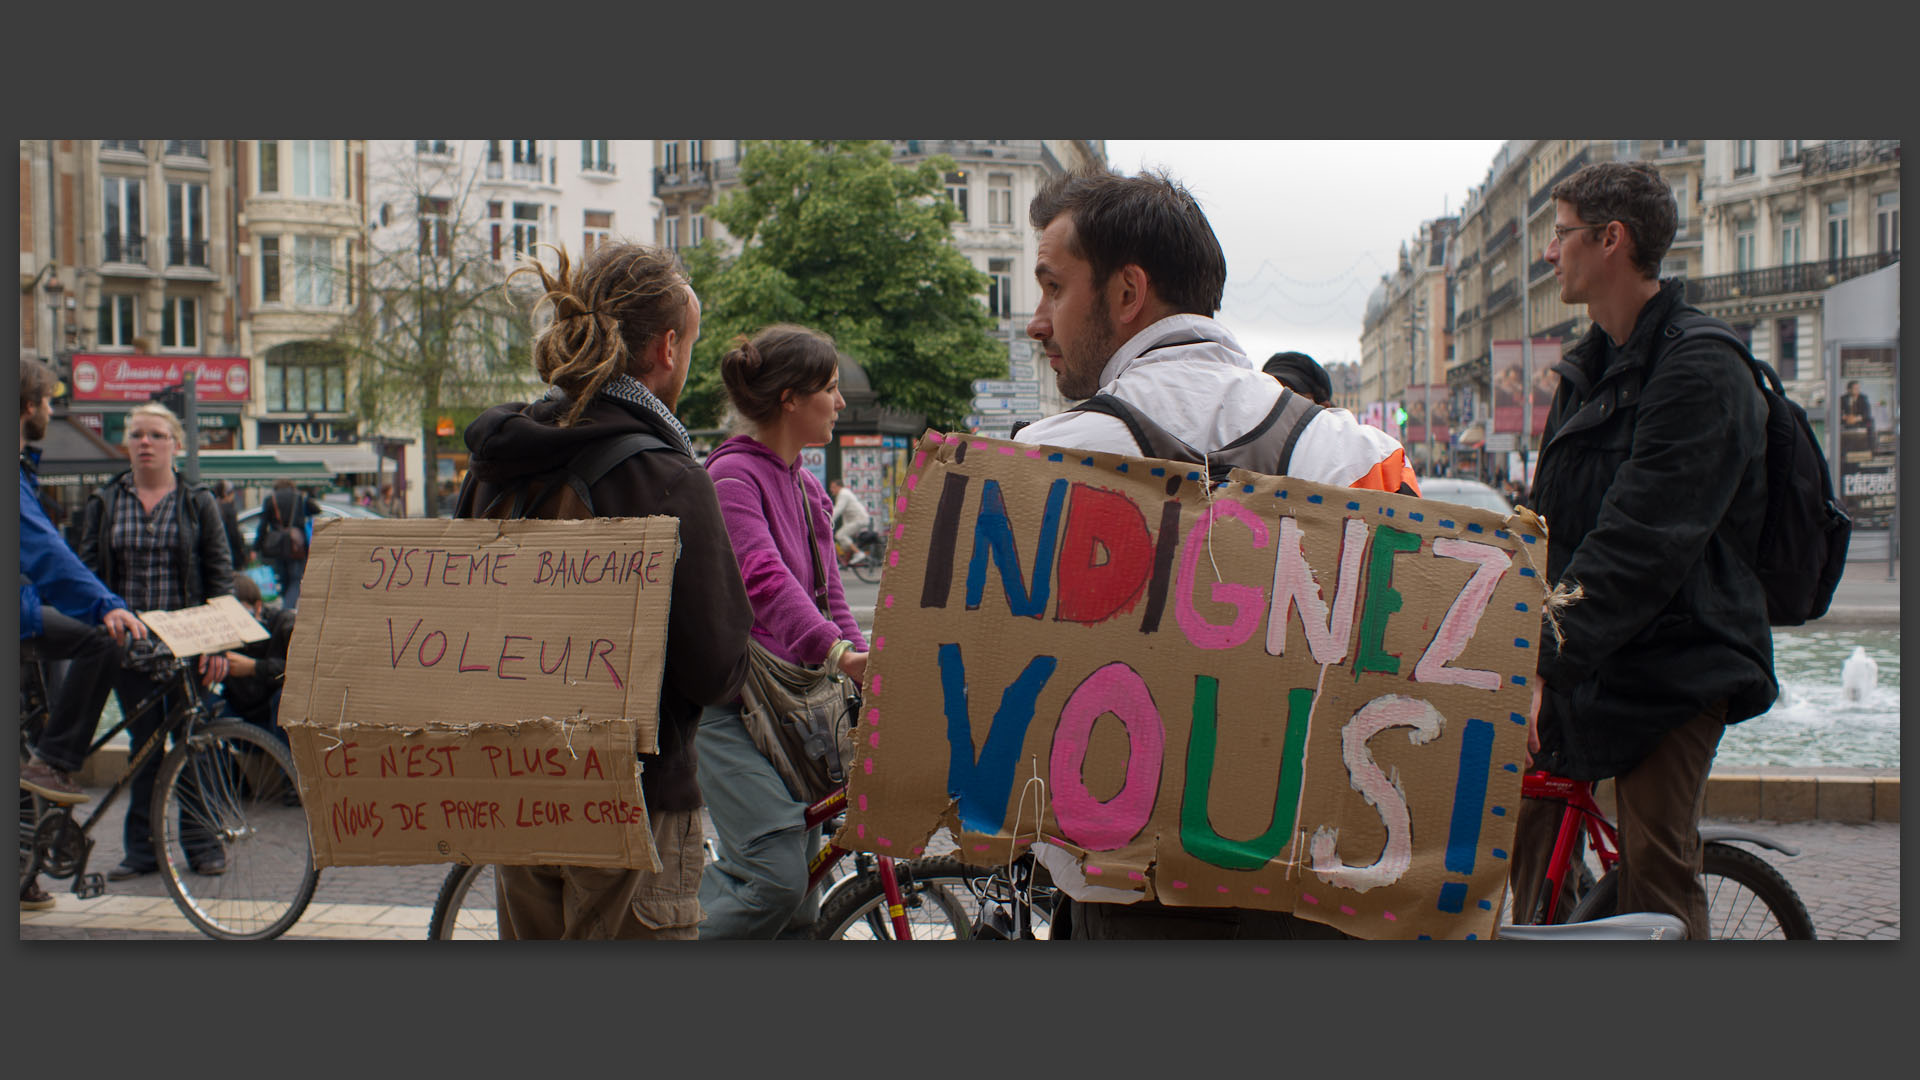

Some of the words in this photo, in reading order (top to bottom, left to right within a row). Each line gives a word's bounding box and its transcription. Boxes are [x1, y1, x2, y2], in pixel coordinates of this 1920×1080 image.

[279, 423, 338, 444] PAUL
[362, 546, 517, 592] SYSTEME
[532, 548, 664, 590] BANCAIRE
[386, 617, 625, 690] VOLEUR
[323, 742, 360, 779] CE
[380, 745, 460, 778] N'EST
[481, 744, 567, 779] PLUS
[584, 746, 605, 780] A
[332, 797, 384, 843] NOUS
[391, 802, 428, 831] DE
[440, 799, 505, 831] PAYER
[515, 797, 573, 828] LEUR
